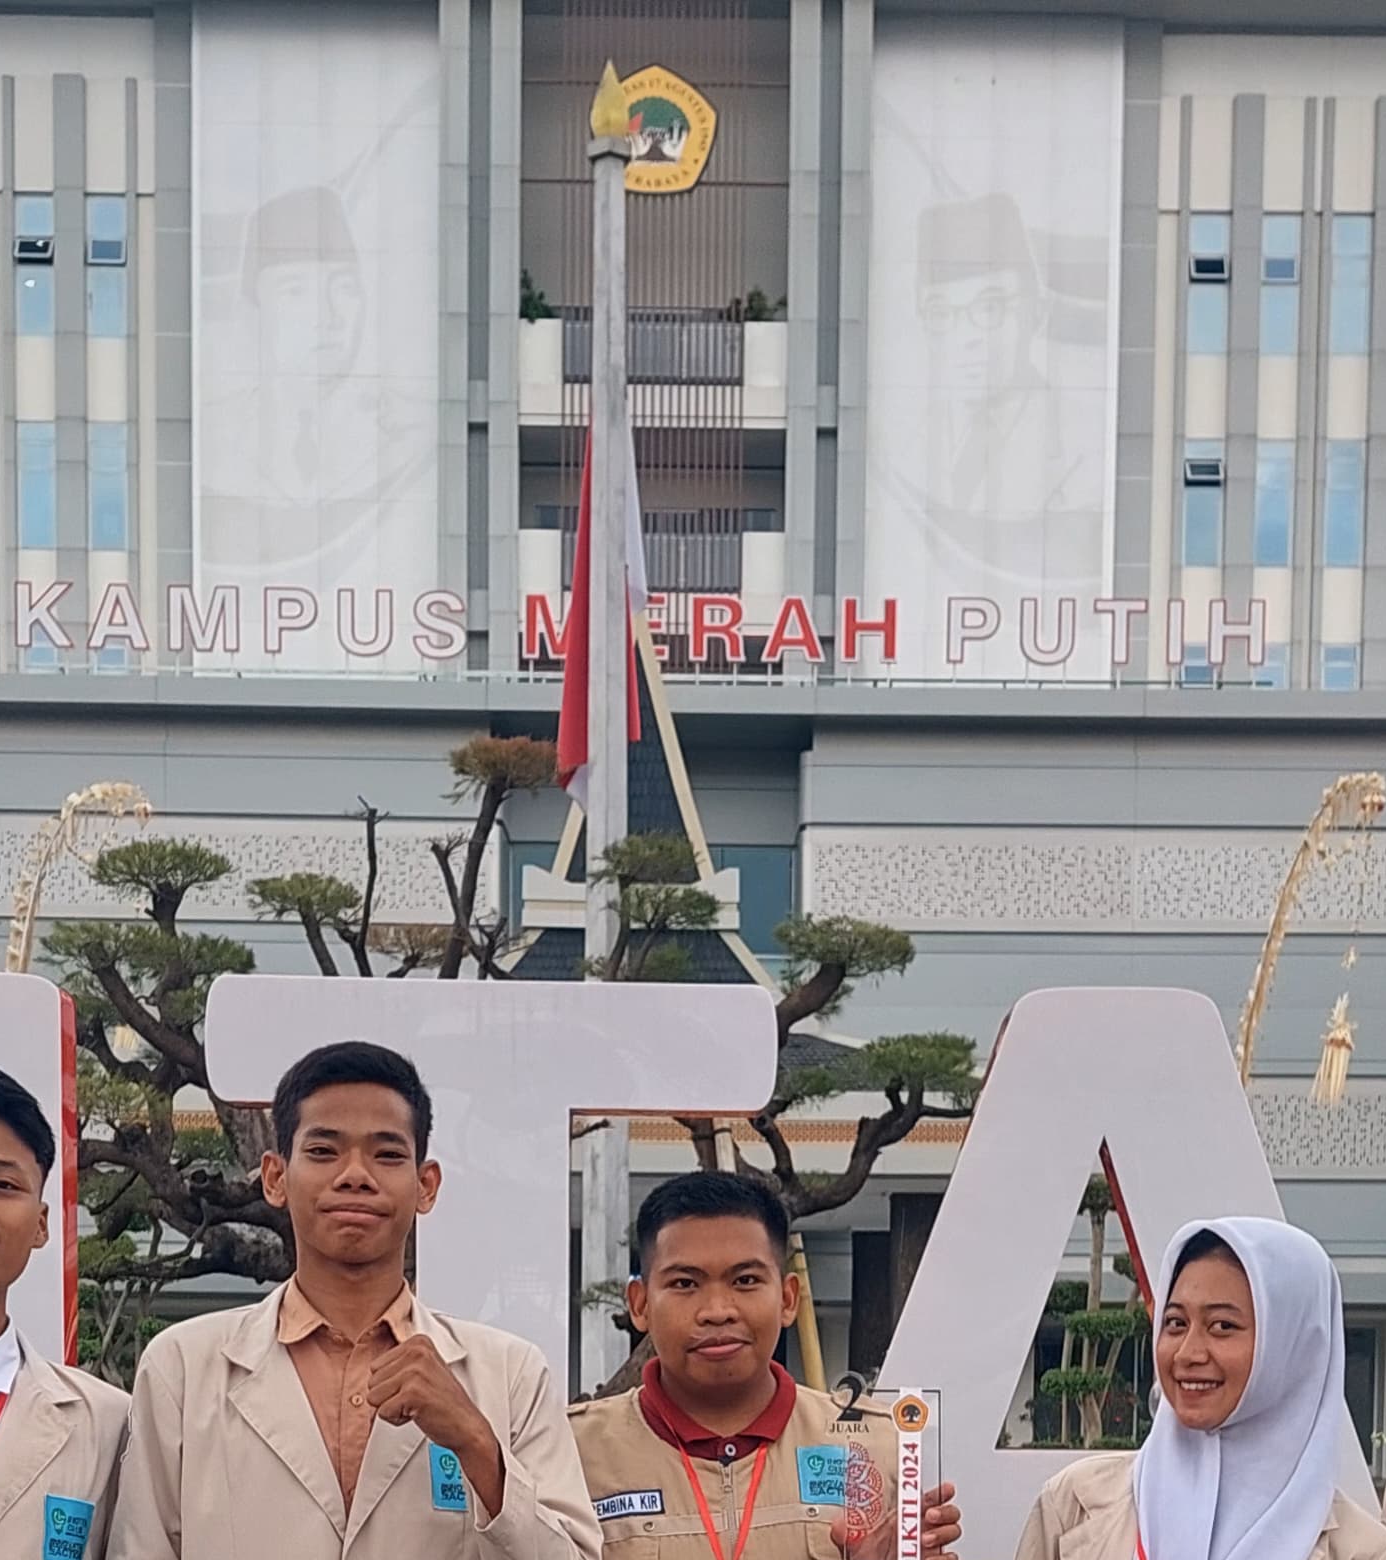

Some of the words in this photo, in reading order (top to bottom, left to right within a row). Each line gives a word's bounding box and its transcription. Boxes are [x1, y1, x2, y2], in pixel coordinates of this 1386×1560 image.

[13, 580, 469, 661] KAMPUS
[946, 596, 1266, 666] PUTIH
[835, 1374, 864, 1422] 2
[829, 1422, 869, 1434] JUARA
[902, 1441, 919, 1491] 2024
[639, 1495, 659, 1510] KIR
[902, 1498, 918, 1559] LKTI
